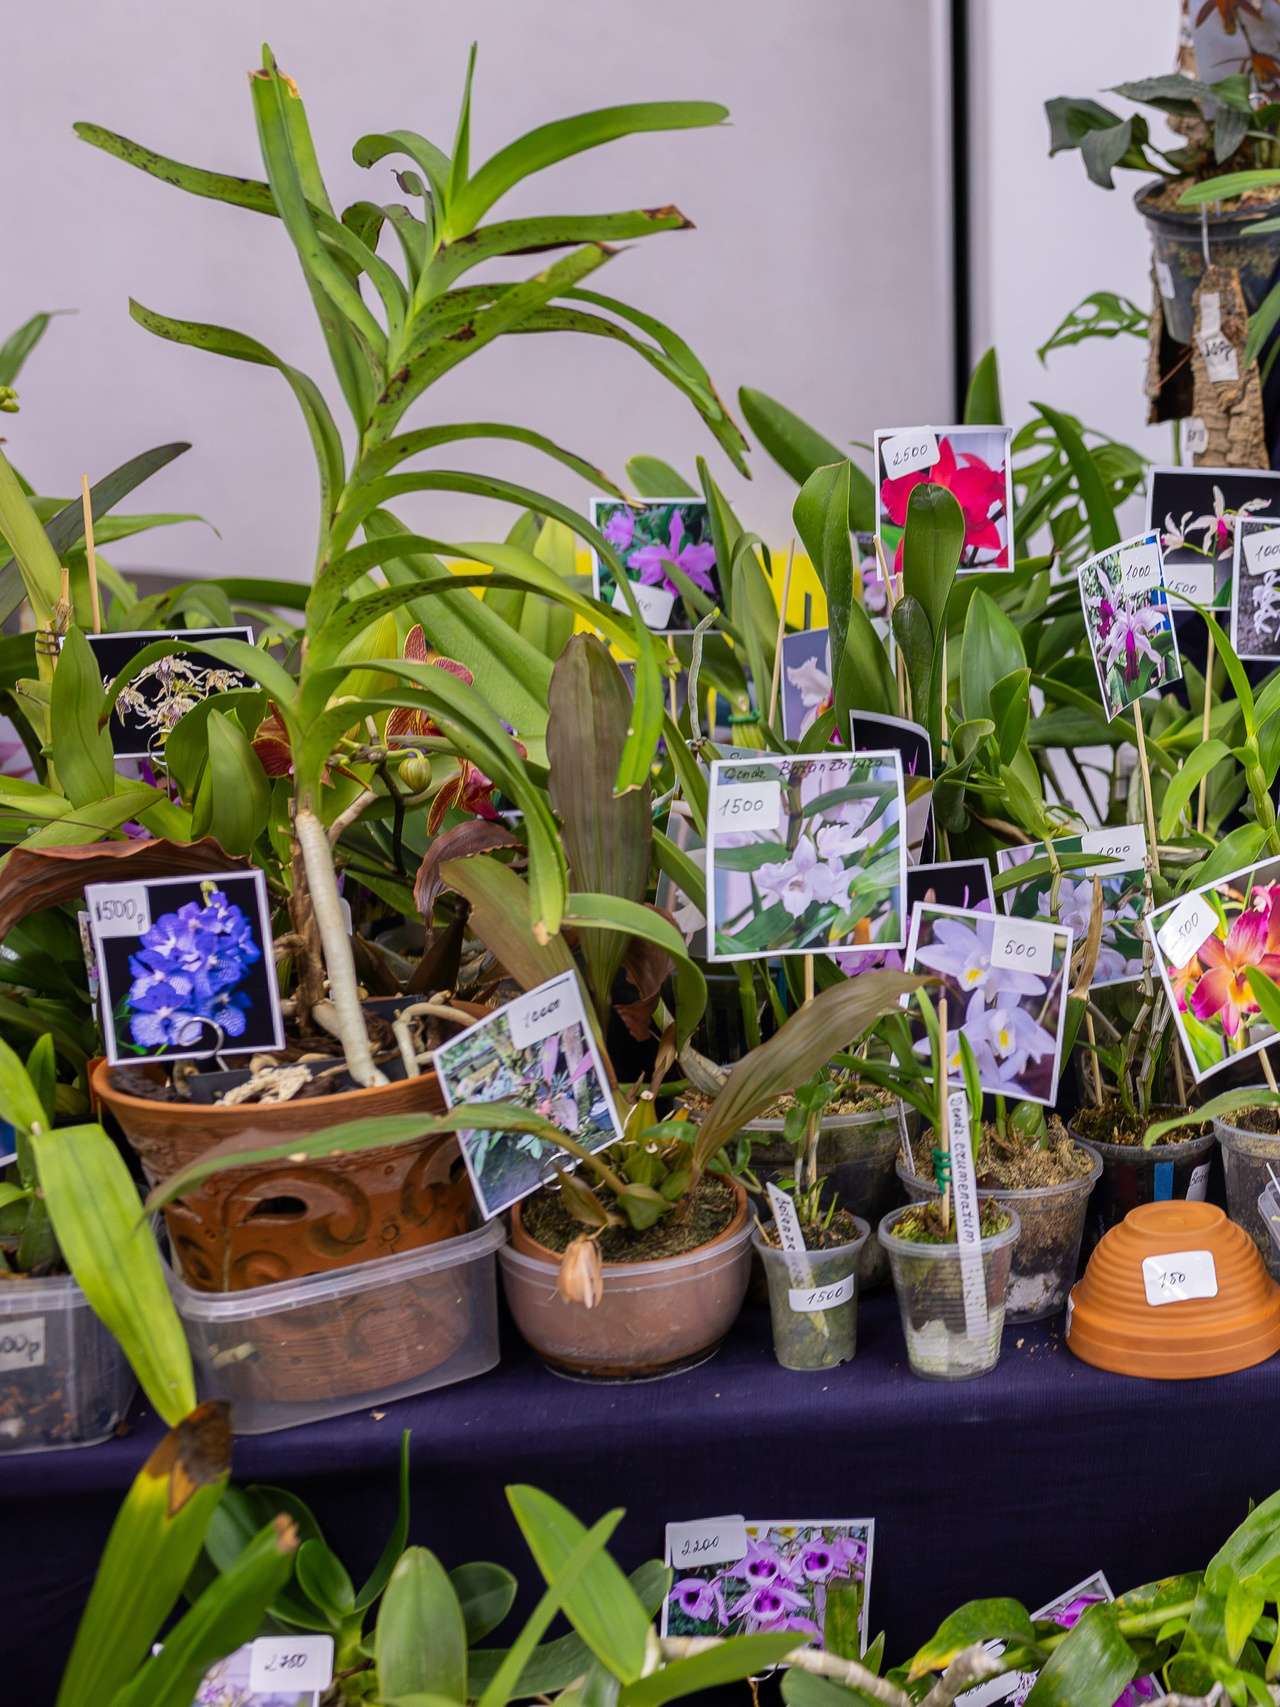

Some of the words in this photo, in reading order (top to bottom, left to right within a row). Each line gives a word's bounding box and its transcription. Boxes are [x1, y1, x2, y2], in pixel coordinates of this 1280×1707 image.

[892, 444, 928, 467] 2500
[1126, 564, 1151, 582] 1000
[719, 798, 764, 816] 1500
[1004, 939, 1037, 958] 500
[807, 1286, 844, 1305] 1500
[681, 1535, 720, 1556] 2200
